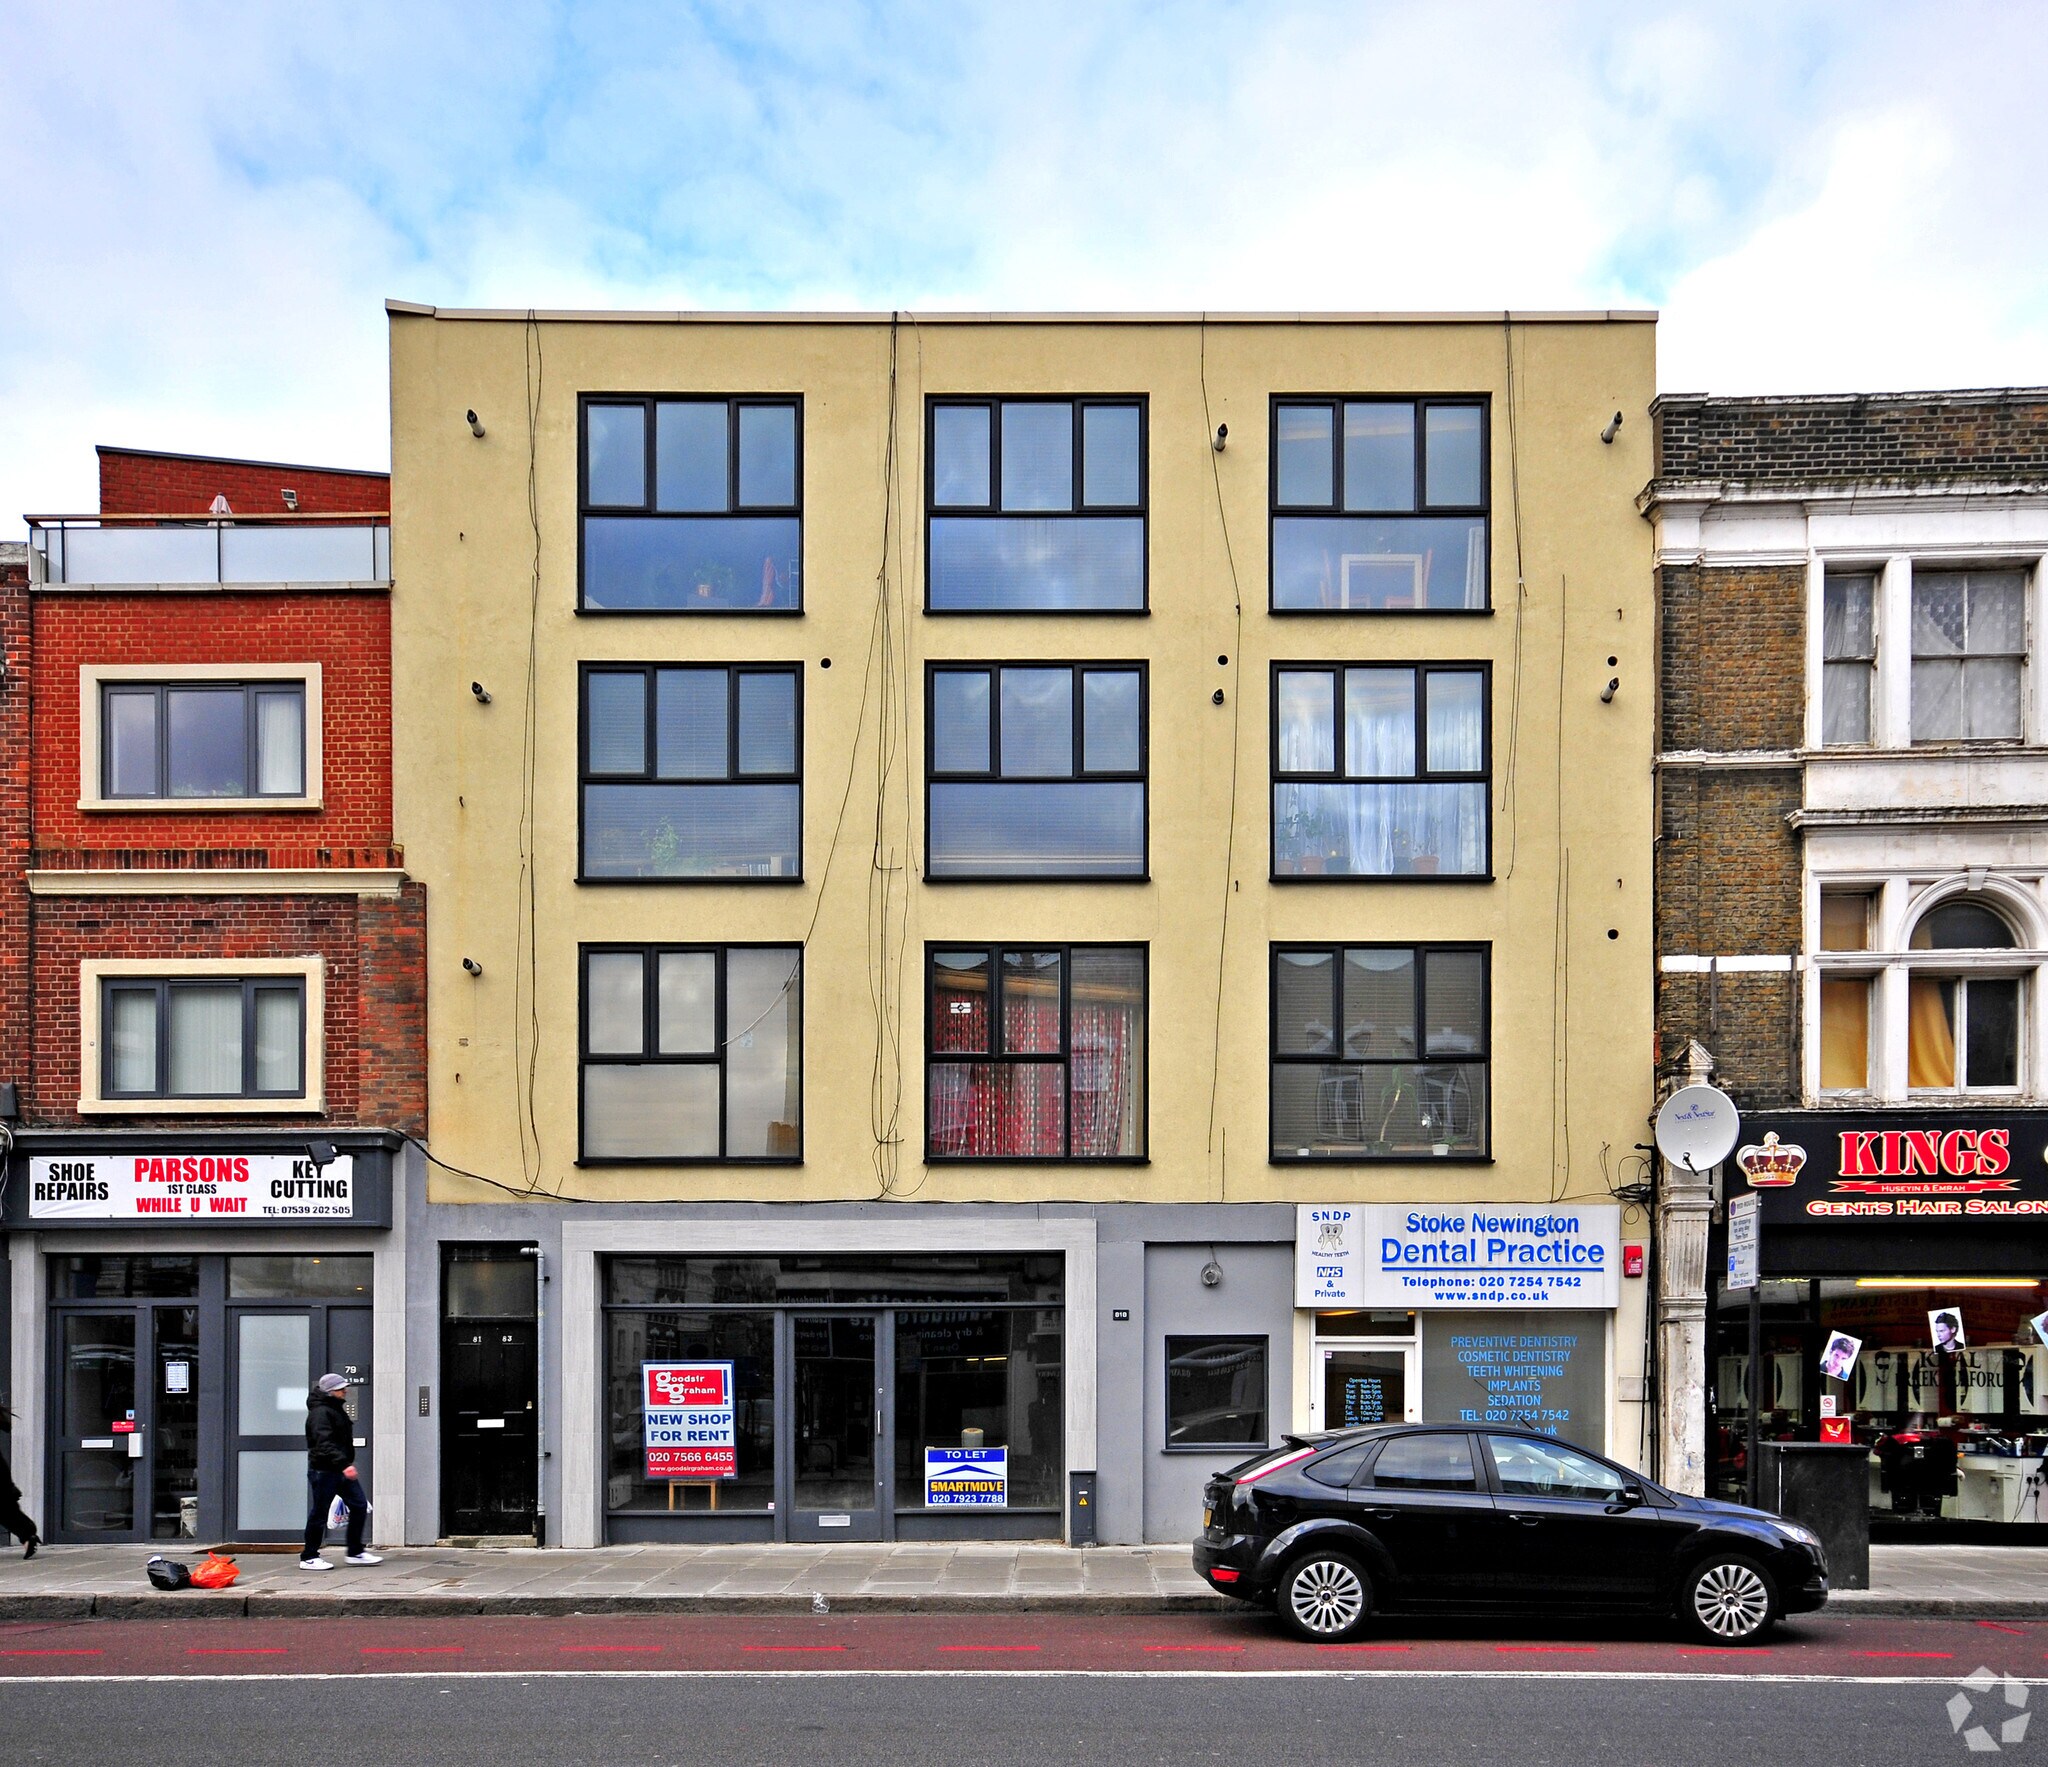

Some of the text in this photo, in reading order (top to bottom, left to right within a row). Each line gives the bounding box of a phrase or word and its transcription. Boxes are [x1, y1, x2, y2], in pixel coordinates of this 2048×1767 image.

[1838, 1129, 2010, 1176] KINGS
[50, 1163, 95, 1182] SHOE
[135, 1158, 249, 1183] PARSONS
[35, 1182, 109, 1201] REPAIRS
[167, 1184, 217, 1194] 1ST CLASS
[271, 1180, 348, 1199] CUTTING
[1882, 1185, 1921, 1193] HUSEYIN
[1923, 1185, 1930, 1193] &
[136, 1198, 248, 1213] WHILE U WAIT
[262, 1206, 350, 1214] TEL: 07539 202 505
[1806, 1199, 2048, 1216] GENTS HAIR SALON
[1312, 1211, 1351, 1222] SNDP
[1406, 1212, 1580, 1237] Stoke Newington
[1312, 1250, 1350, 1258] HEALTHY TEETH
[1382, 1238, 1605, 1264] Dental Practice
[1318, 1267, 1342, 1277] NHS
[1326, 1280, 1334, 1288] &
[1402, 1277, 1582, 1288] Telephone: 020 7254 7542
[1315, 1290, 1346, 1298] Private
[1435, 1291, 1549, 1302] www.sndp.co.uk
[1451, 1336, 1578, 1348] PREVENTIVE DENTISTRY
[1458, 1351, 1571, 1362] COSMETIC DENTISTRY
[345, 1366, 357, 1374] 79
[1467, 1366, 1563, 1377] TEETH WHITENING
[656, 1372, 705, 1392] goodsir
[1488, 1380, 1541, 1392] IMPLANTS
[669, 1384, 716, 1404] graham
[1488, 1395, 1542, 1407] SEDATION
[648, 1414, 731, 1425] NEW SHOP
[1460, 1410, 1569, 1421] TEL: 020 7254 7542
[651, 1431, 730, 1441] FOR RENT
[648, 1452, 733, 1462] 020 7566 6455
[945, 1451, 988, 1459] TO LET
[930, 1482, 1004, 1492] SMARTMOVE
[932, 1494, 1004, 1503] 020 7923 7788
